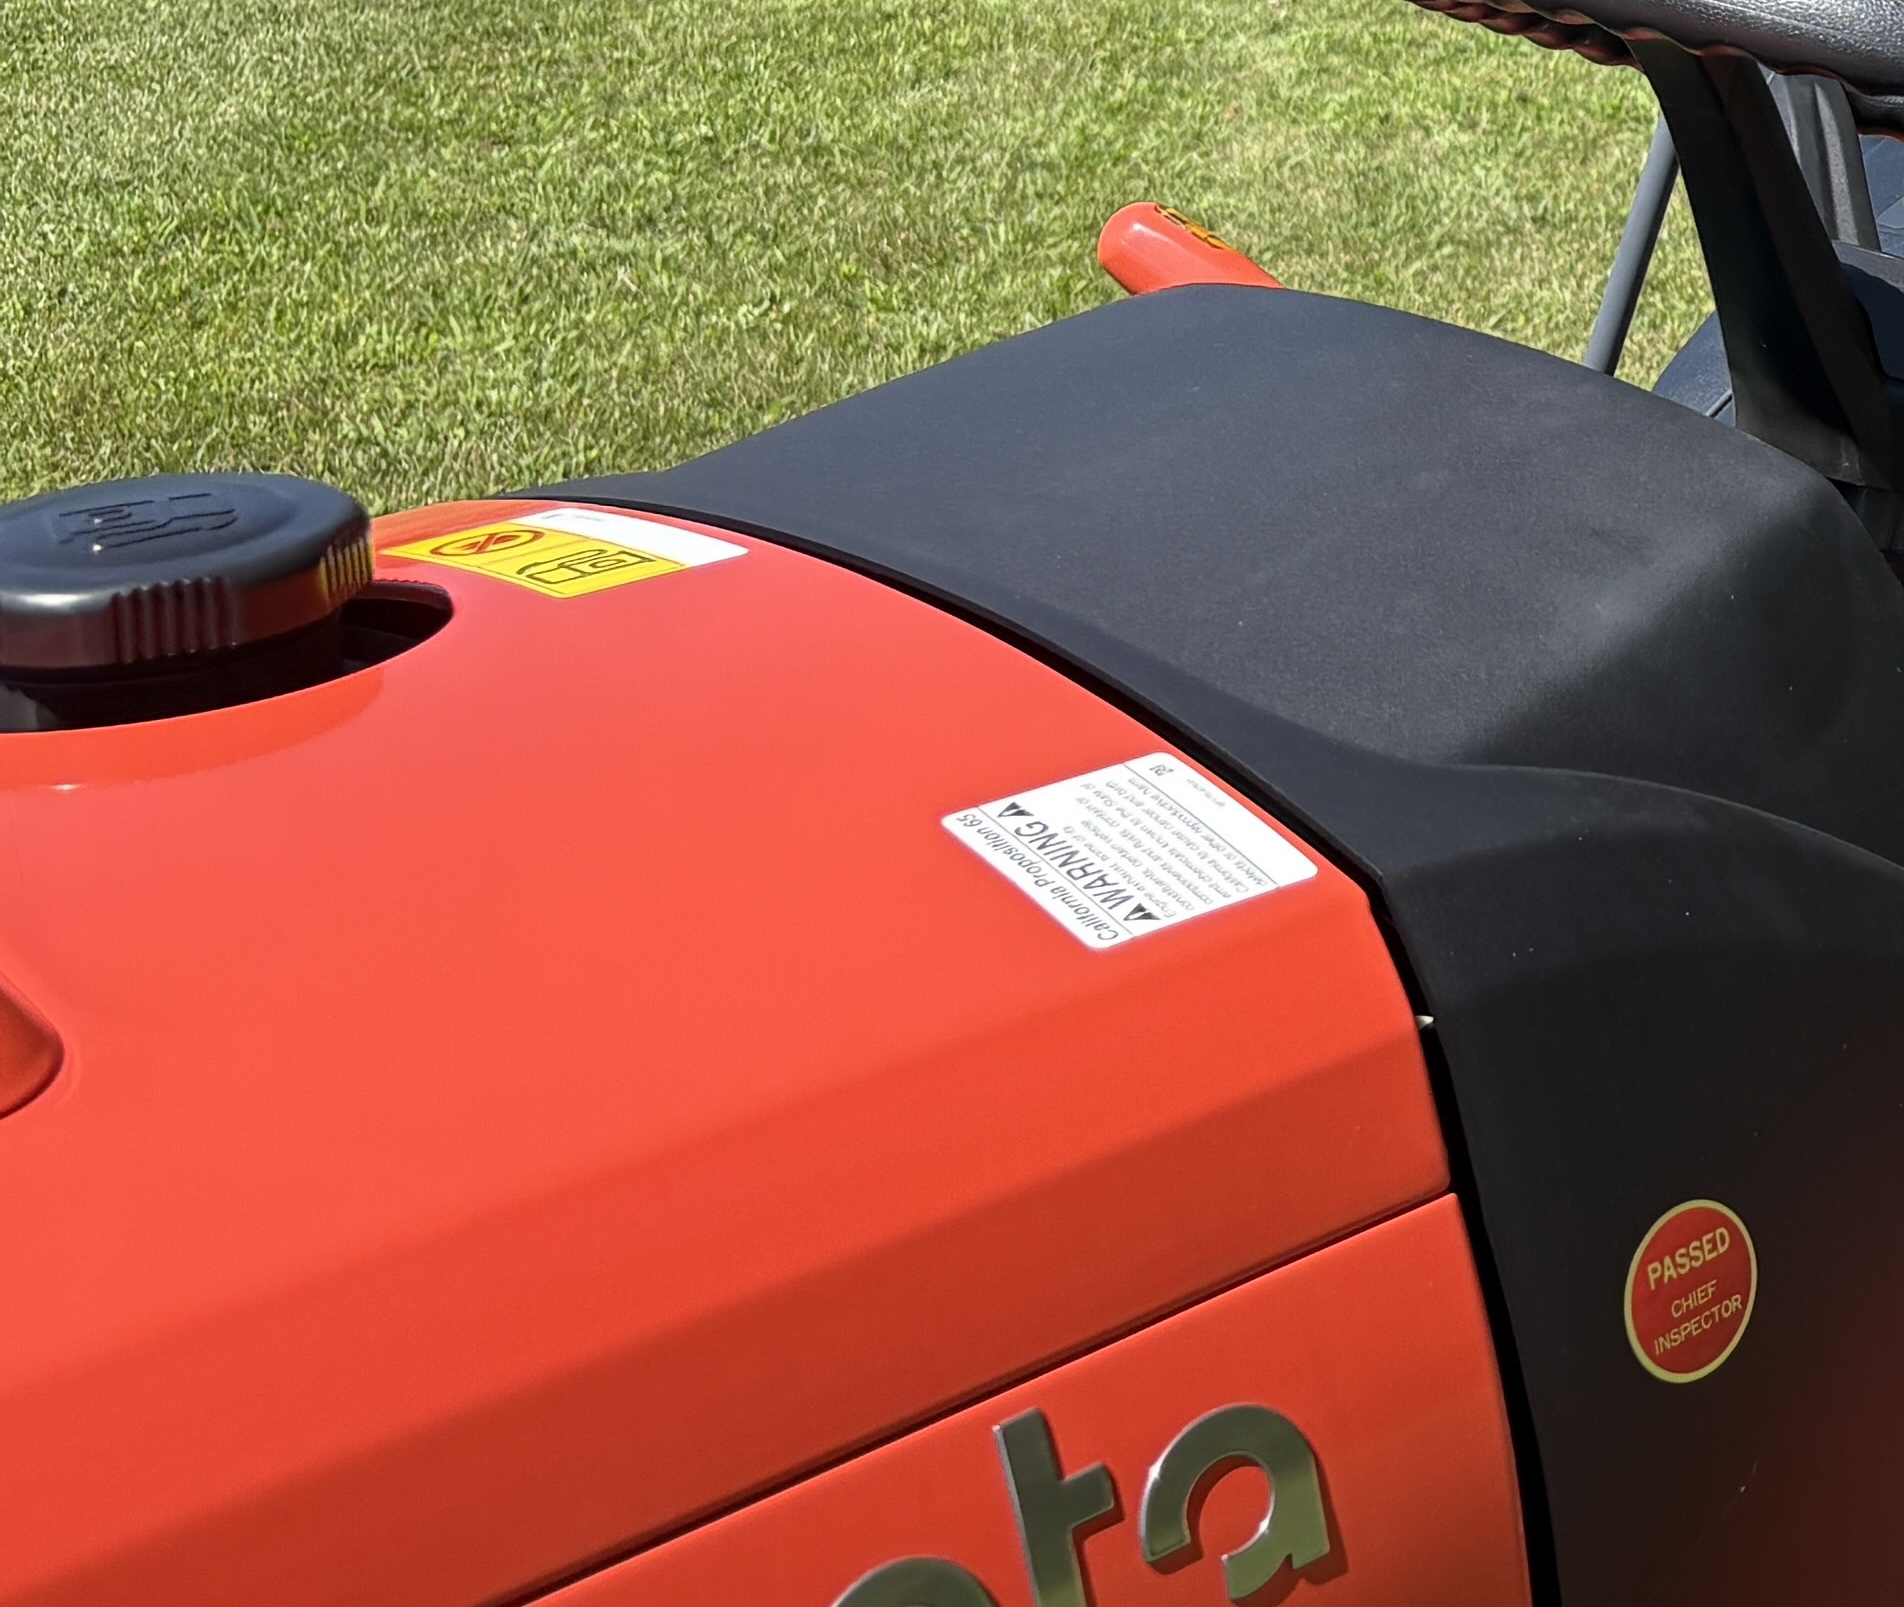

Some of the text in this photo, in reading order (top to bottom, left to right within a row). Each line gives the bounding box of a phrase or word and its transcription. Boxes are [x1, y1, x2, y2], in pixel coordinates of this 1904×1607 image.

[958, 815, 1118, 939] California Proposition 65
[1015, 822, 1133, 909] WARNING
[1647, 1226, 1731, 1291] PASSED
[1653, 1293, 1743, 1357] INSPECTOR
[1670, 1279, 1718, 1318] CHIEF
